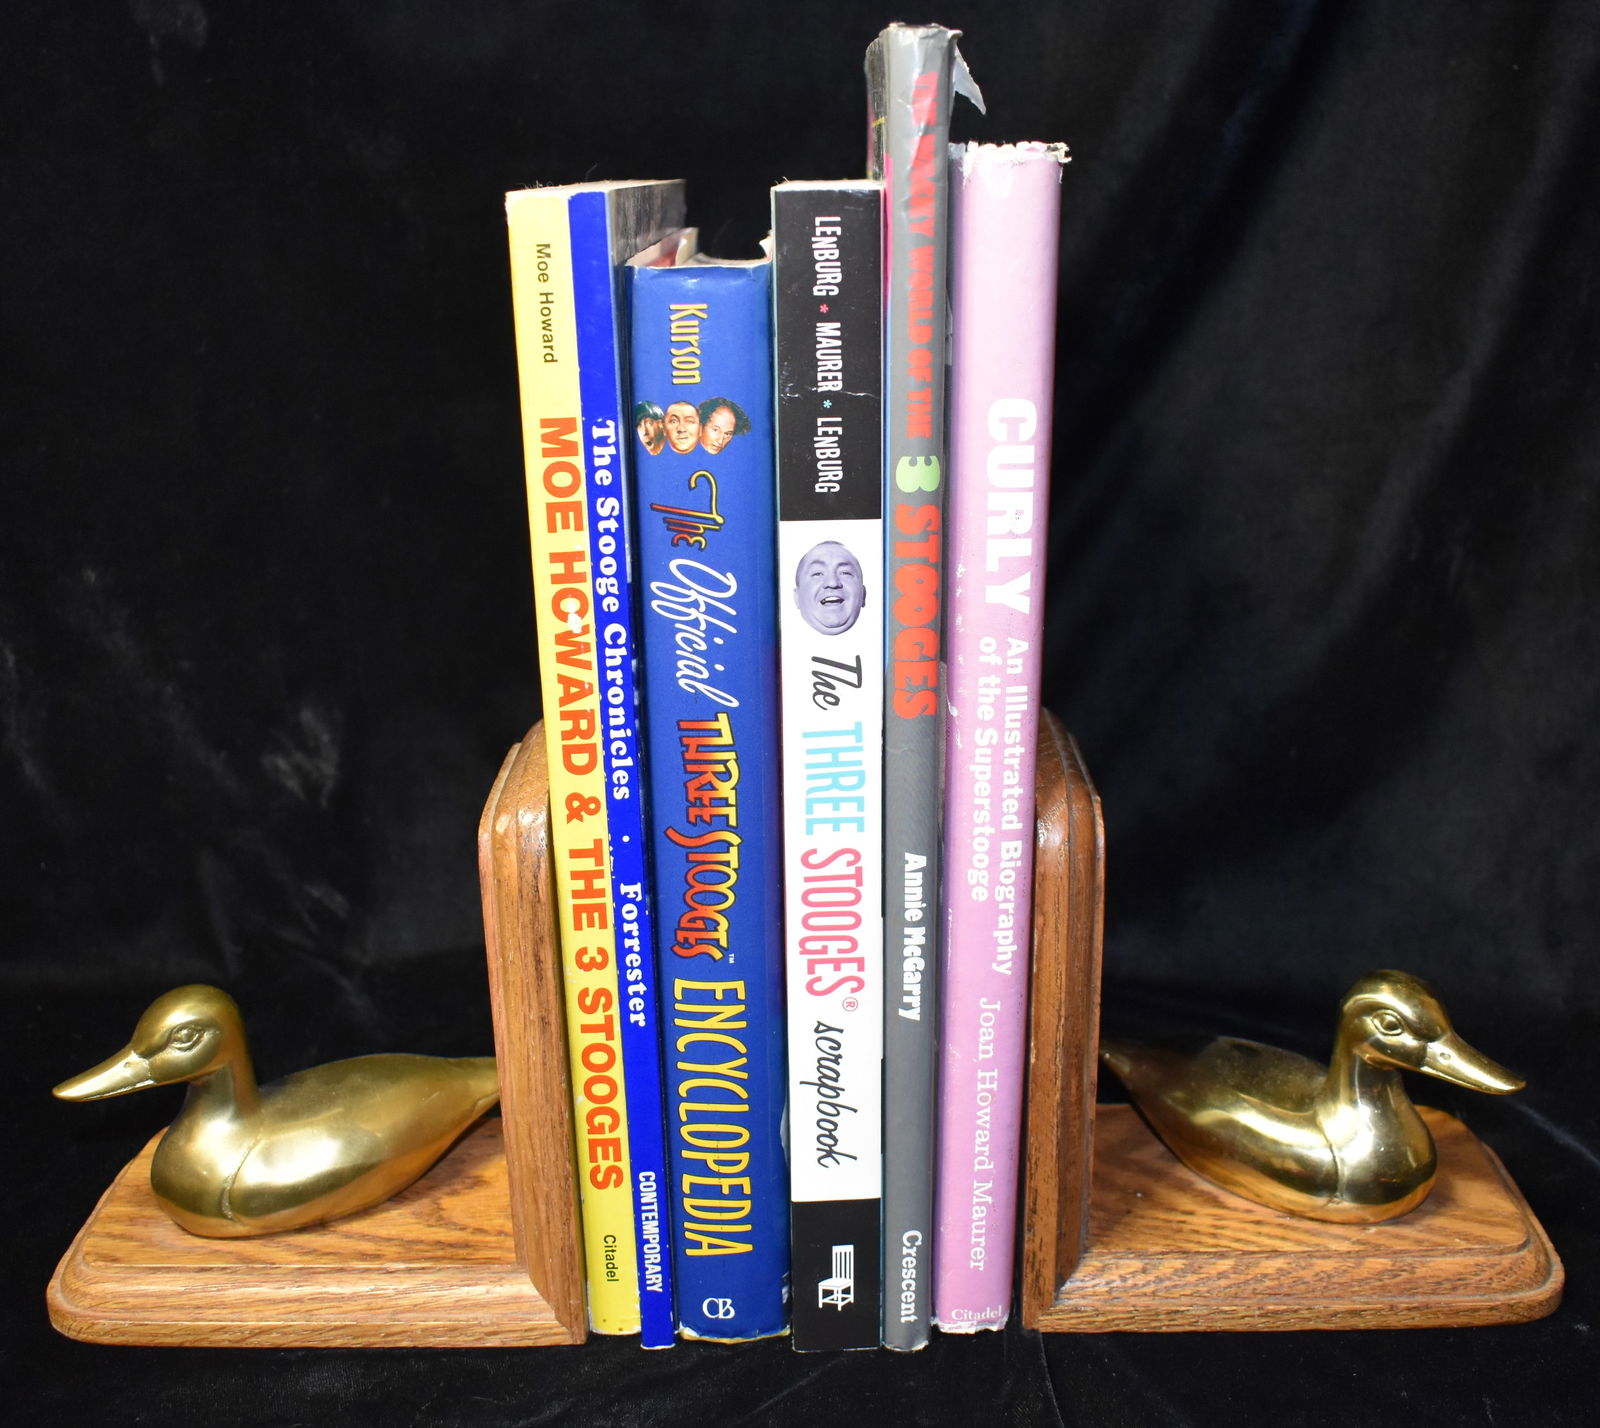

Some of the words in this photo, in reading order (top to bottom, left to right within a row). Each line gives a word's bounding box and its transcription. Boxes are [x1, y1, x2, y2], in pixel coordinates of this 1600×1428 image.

[911, 72, 938, 126] THE
[536, 243, 550, 283] Moe
[811, 216, 842, 297] LENBURG
[907, 245, 934, 344] WORLD
[540, 292, 558, 363] Howard
[669, 304, 708, 385] Kurson
[815, 322, 842, 392] MAURER
[907, 348, 932, 383] OF
[592, 420, 616, 486] The
[813, 417, 843, 493] LENBURG
[906, 387, 932, 439] THE
[540, 417, 584, 533] MOE
[650, 470, 725, 550] The
[896, 455, 940, 493] 3
[985, 398, 1037, 614] CURLY
[596, 497, 620, 613] Stooge
[650, 559, 739, 708] Official
[893, 504, 940, 719] STOOGES
[978, 636, 1003, 665] of
[1005, 637, 1029, 674] An
[549, 551, 598, 776] HOWARD
[811, 655, 863, 710] The
[976, 679, 1000, 721] the
[603, 623, 633, 800] Chronicles
[677, 712, 740, 828] THREE
[802, 721, 866, 836] THREE
[1001, 686, 1028, 831] Illustrated
[565, 792, 601, 824] &
[968, 728, 998, 901] Superstooge
[569, 839, 607, 930] THE
[904, 852, 927, 922] Annie
[992, 840, 1023, 976] Biography
[575, 946, 609, 972] 3
[620, 882, 647, 1027] Forrester
[899, 927, 926, 1021] McGarry
[978, 997, 1001, 1060] Joan
[577, 987, 624, 1190] STOOGES
[673, 978, 753, 1256] ENCYCLOPEDIA
[799, 1020, 858, 1168] scrapbook
[973, 1069, 998, 1171] Howard
[603, 1234, 619, 1282] Citadel
[639, 1171, 663, 1293] CONTEMPORARY
[969, 1180, 993, 1271] Maurer
[900, 1230, 922, 1323] Crescent
[951, 1305, 1002, 1321] Citadel
